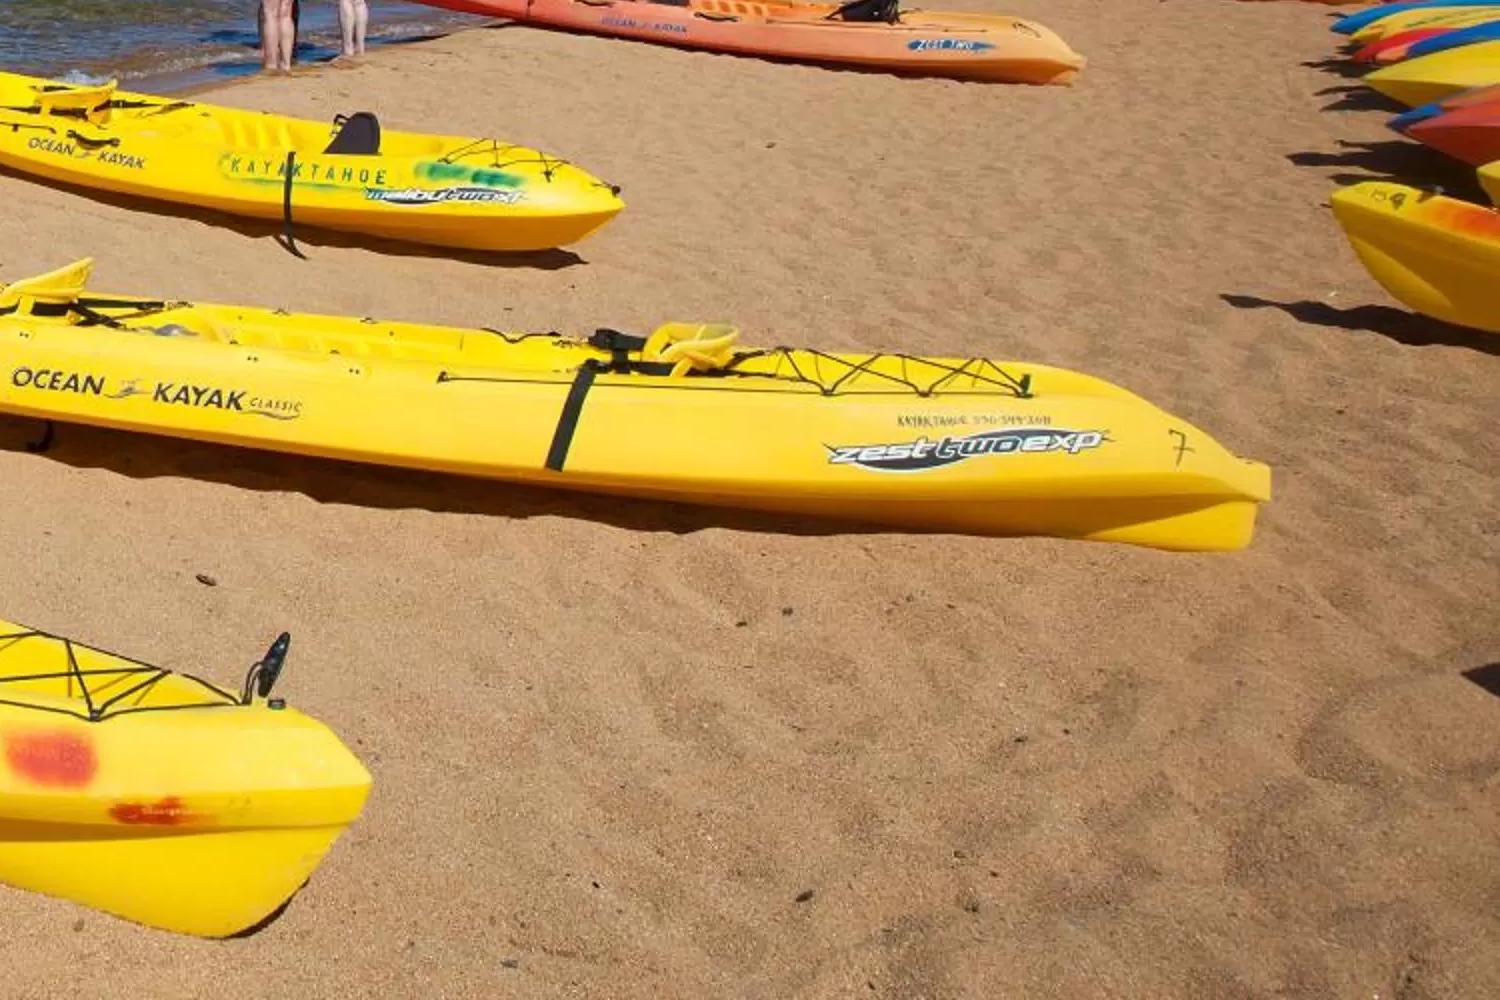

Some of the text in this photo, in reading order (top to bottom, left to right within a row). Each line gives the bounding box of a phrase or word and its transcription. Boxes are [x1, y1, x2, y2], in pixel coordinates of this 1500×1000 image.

[28, 137, 146, 169] OCEAN KAYAK
[11, 366, 304, 414] OCEAN KAYAK CLASSIC
[1168, 428, 1196, 467] 7
